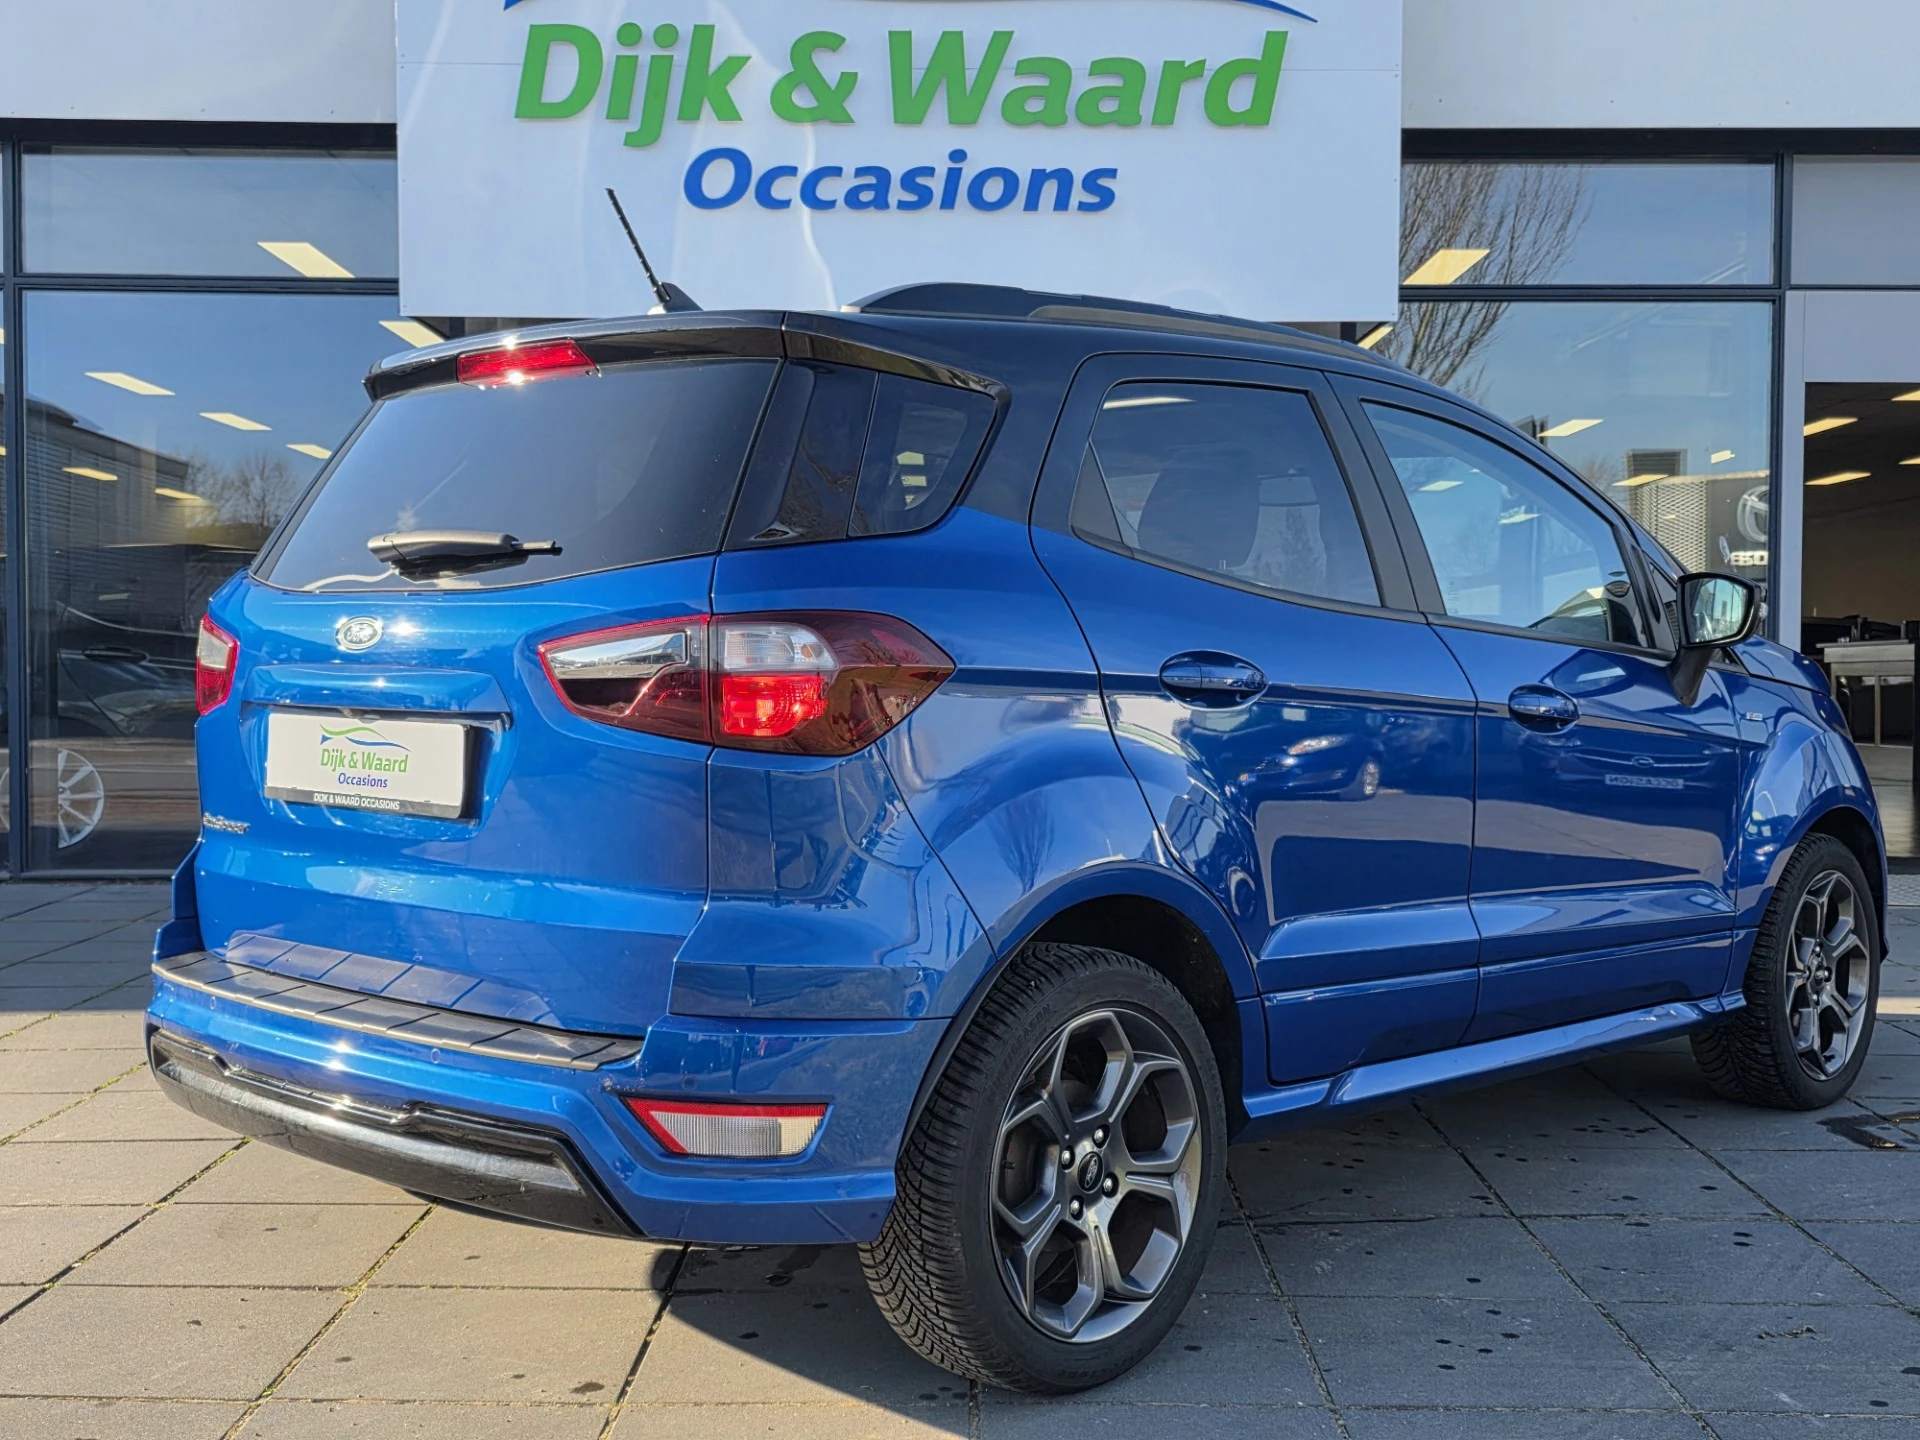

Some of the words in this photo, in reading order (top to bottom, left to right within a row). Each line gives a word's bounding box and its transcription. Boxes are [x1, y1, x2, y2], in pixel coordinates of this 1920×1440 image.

[514, 22, 752, 149] Dijk
[769, 30, 858, 125] &
[888, 29, 1289, 127] Waard
[683, 147, 1118, 213] Occasions
[320, 748, 346, 772] Dijk
[348, 751, 358, 769] &
[361, 752, 408, 773] Waard
[338, 772, 388, 788] Occasions
[334, 794, 360, 806] WAARD
[361, 797, 400, 810] OCCASIONS
